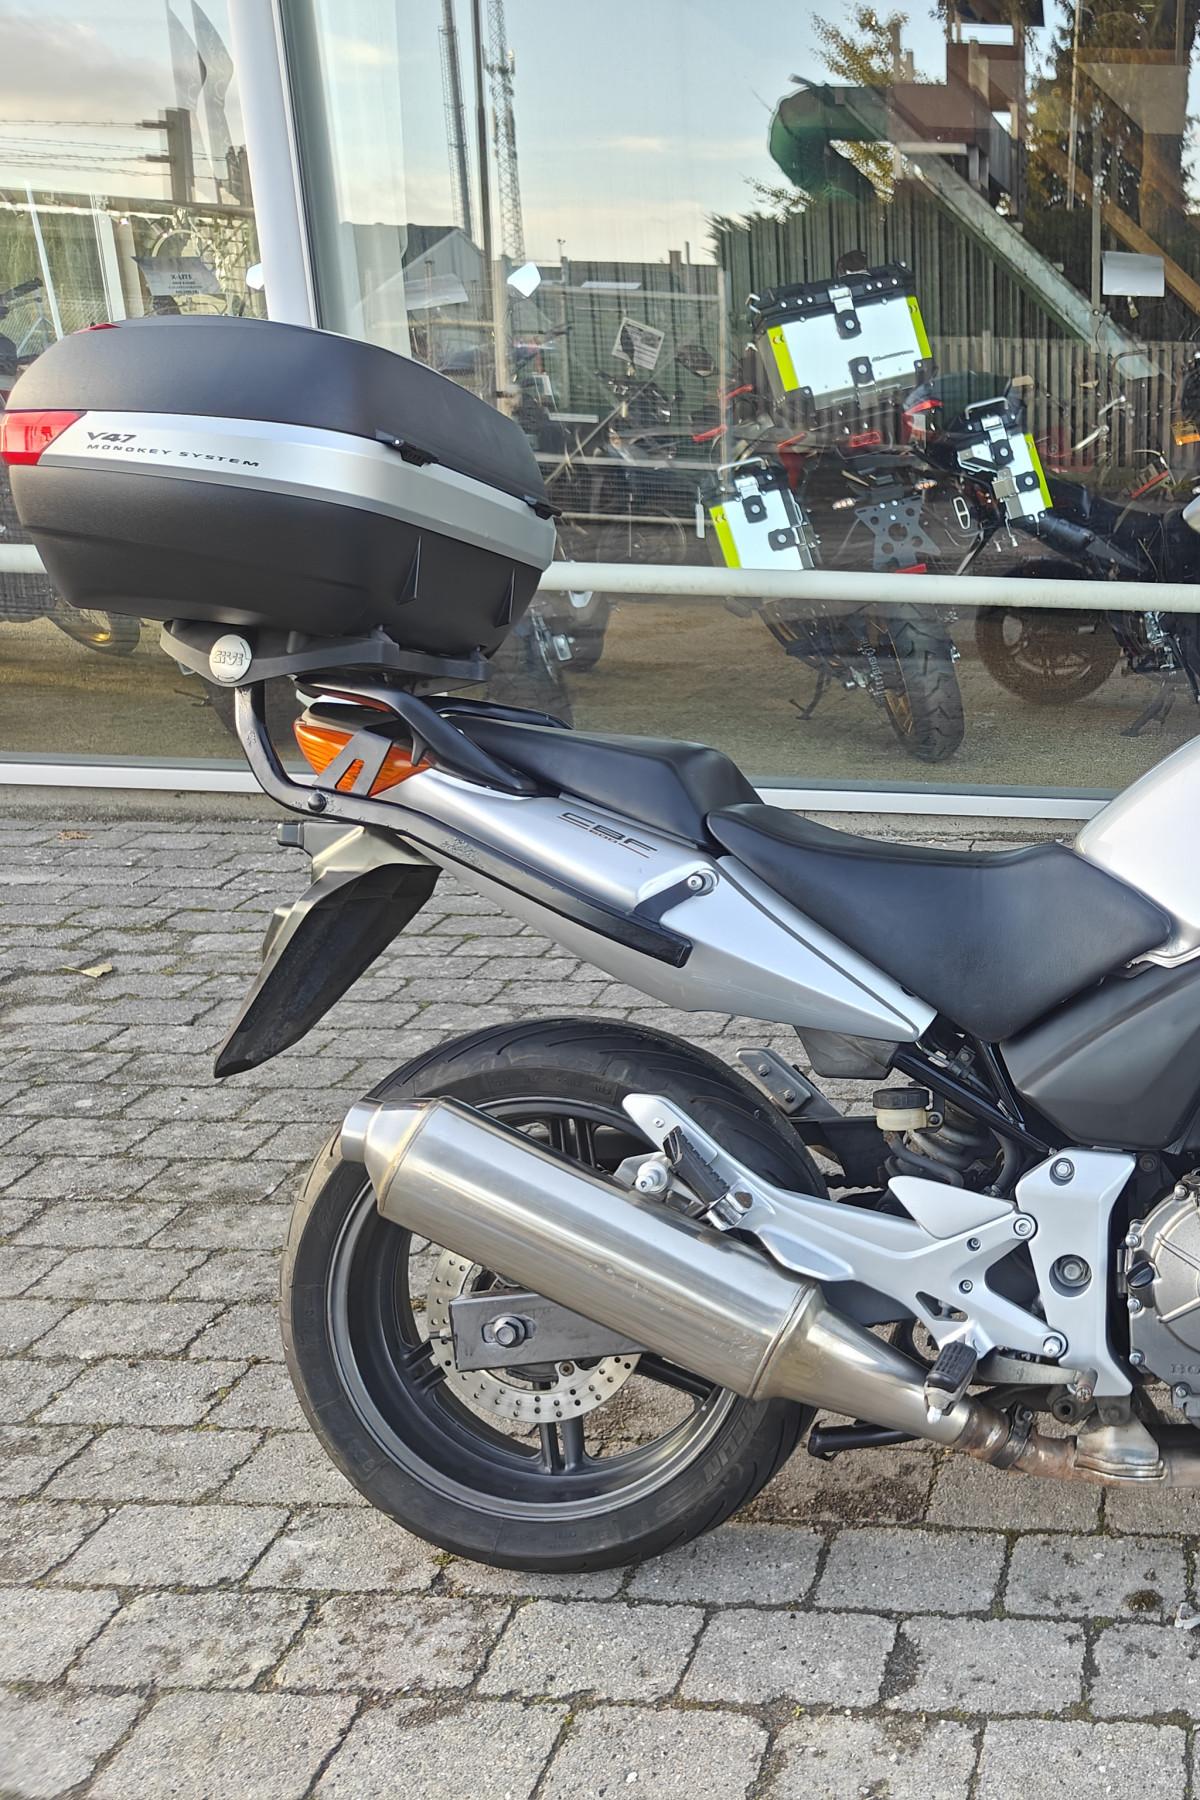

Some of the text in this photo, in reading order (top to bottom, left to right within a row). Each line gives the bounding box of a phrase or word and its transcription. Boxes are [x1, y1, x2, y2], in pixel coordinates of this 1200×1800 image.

[87, 431, 137, 443] V47
[87, 444, 260, 467] MONOKEY SYSTEM
[561, 812, 658, 852] CBF
